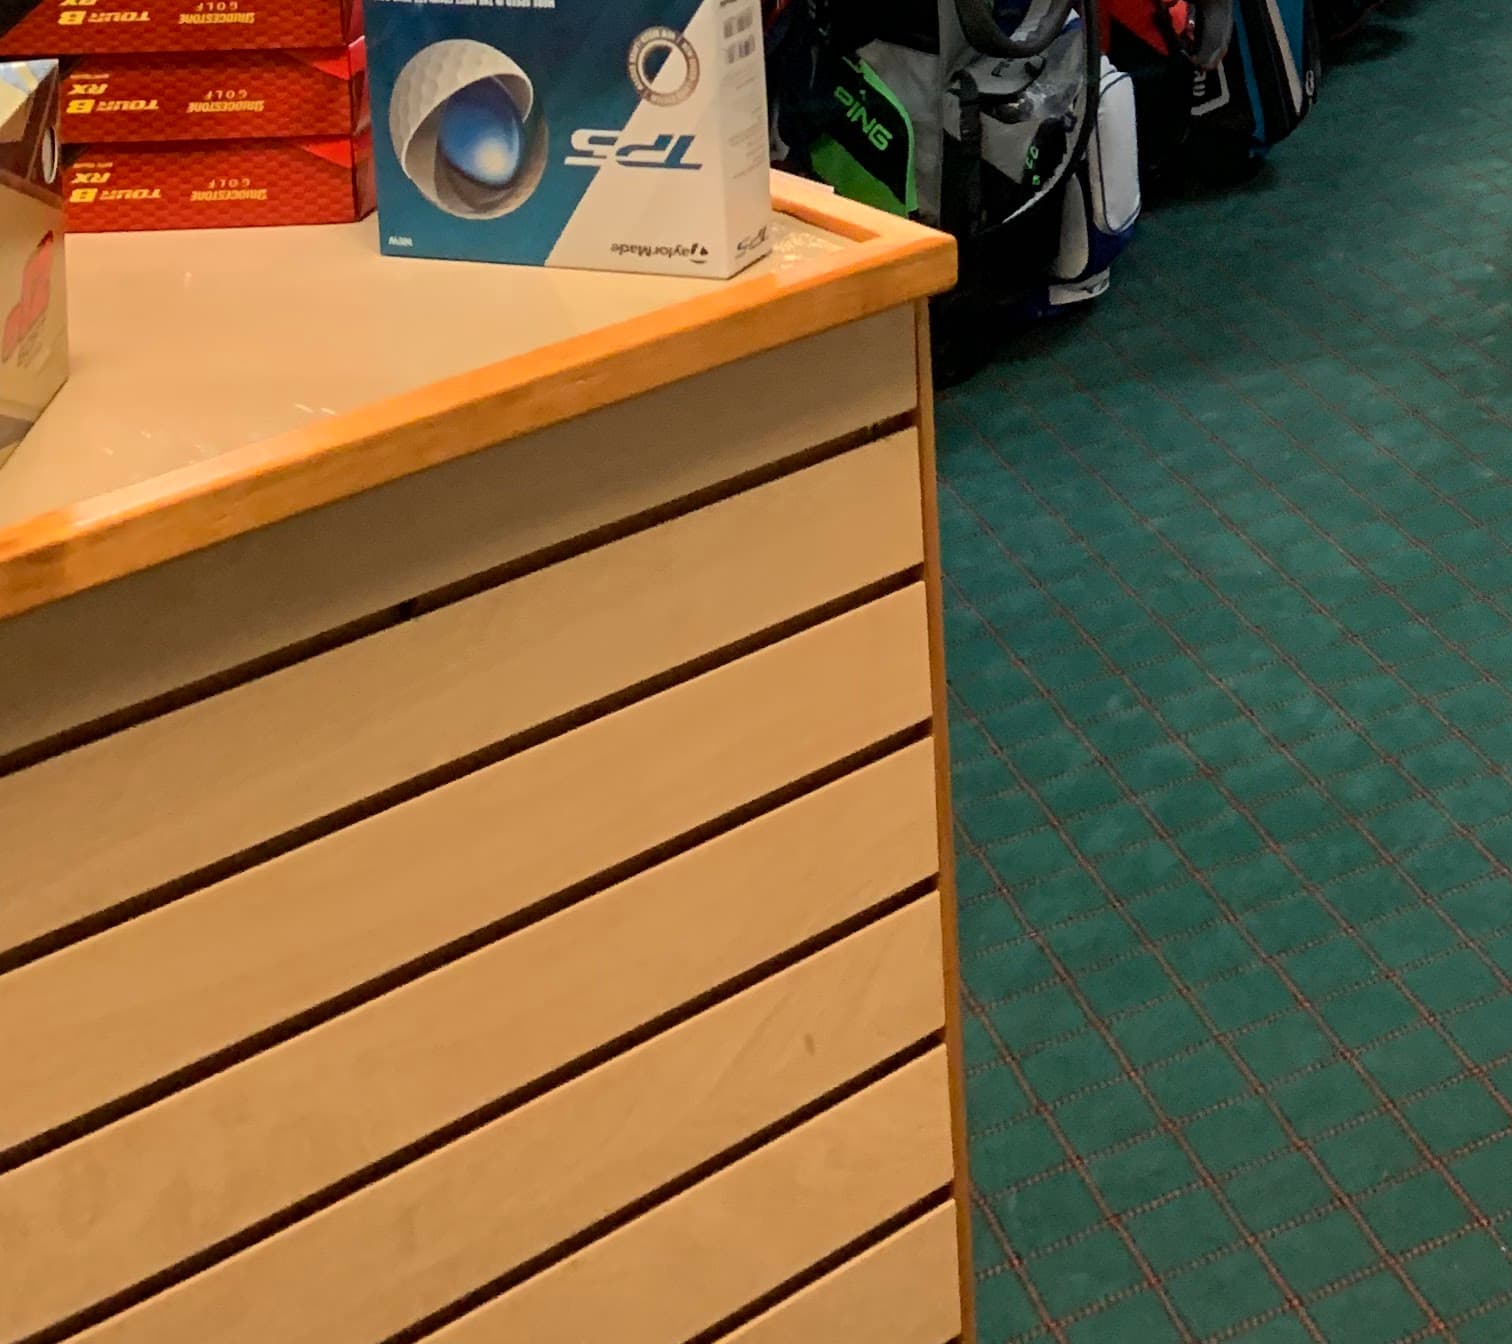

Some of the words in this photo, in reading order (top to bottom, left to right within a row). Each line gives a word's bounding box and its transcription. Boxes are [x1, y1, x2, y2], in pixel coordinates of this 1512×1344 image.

[196, 1, 239, 11] GOLF
[57, 10, 88, 25] B
[67, 83, 109, 96] RX
[204, 89, 248, 100] GOLF
[66, 99, 96, 114] B
[832, 84, 894, 152] PING
[563, 128, 703, 170] TP5
[71, 172, 112, 184] RX
[208, 178, 251, 189] GOLF
[69, 187, 99, 203] B
[610, 241, 709, 265] TaylorMade
